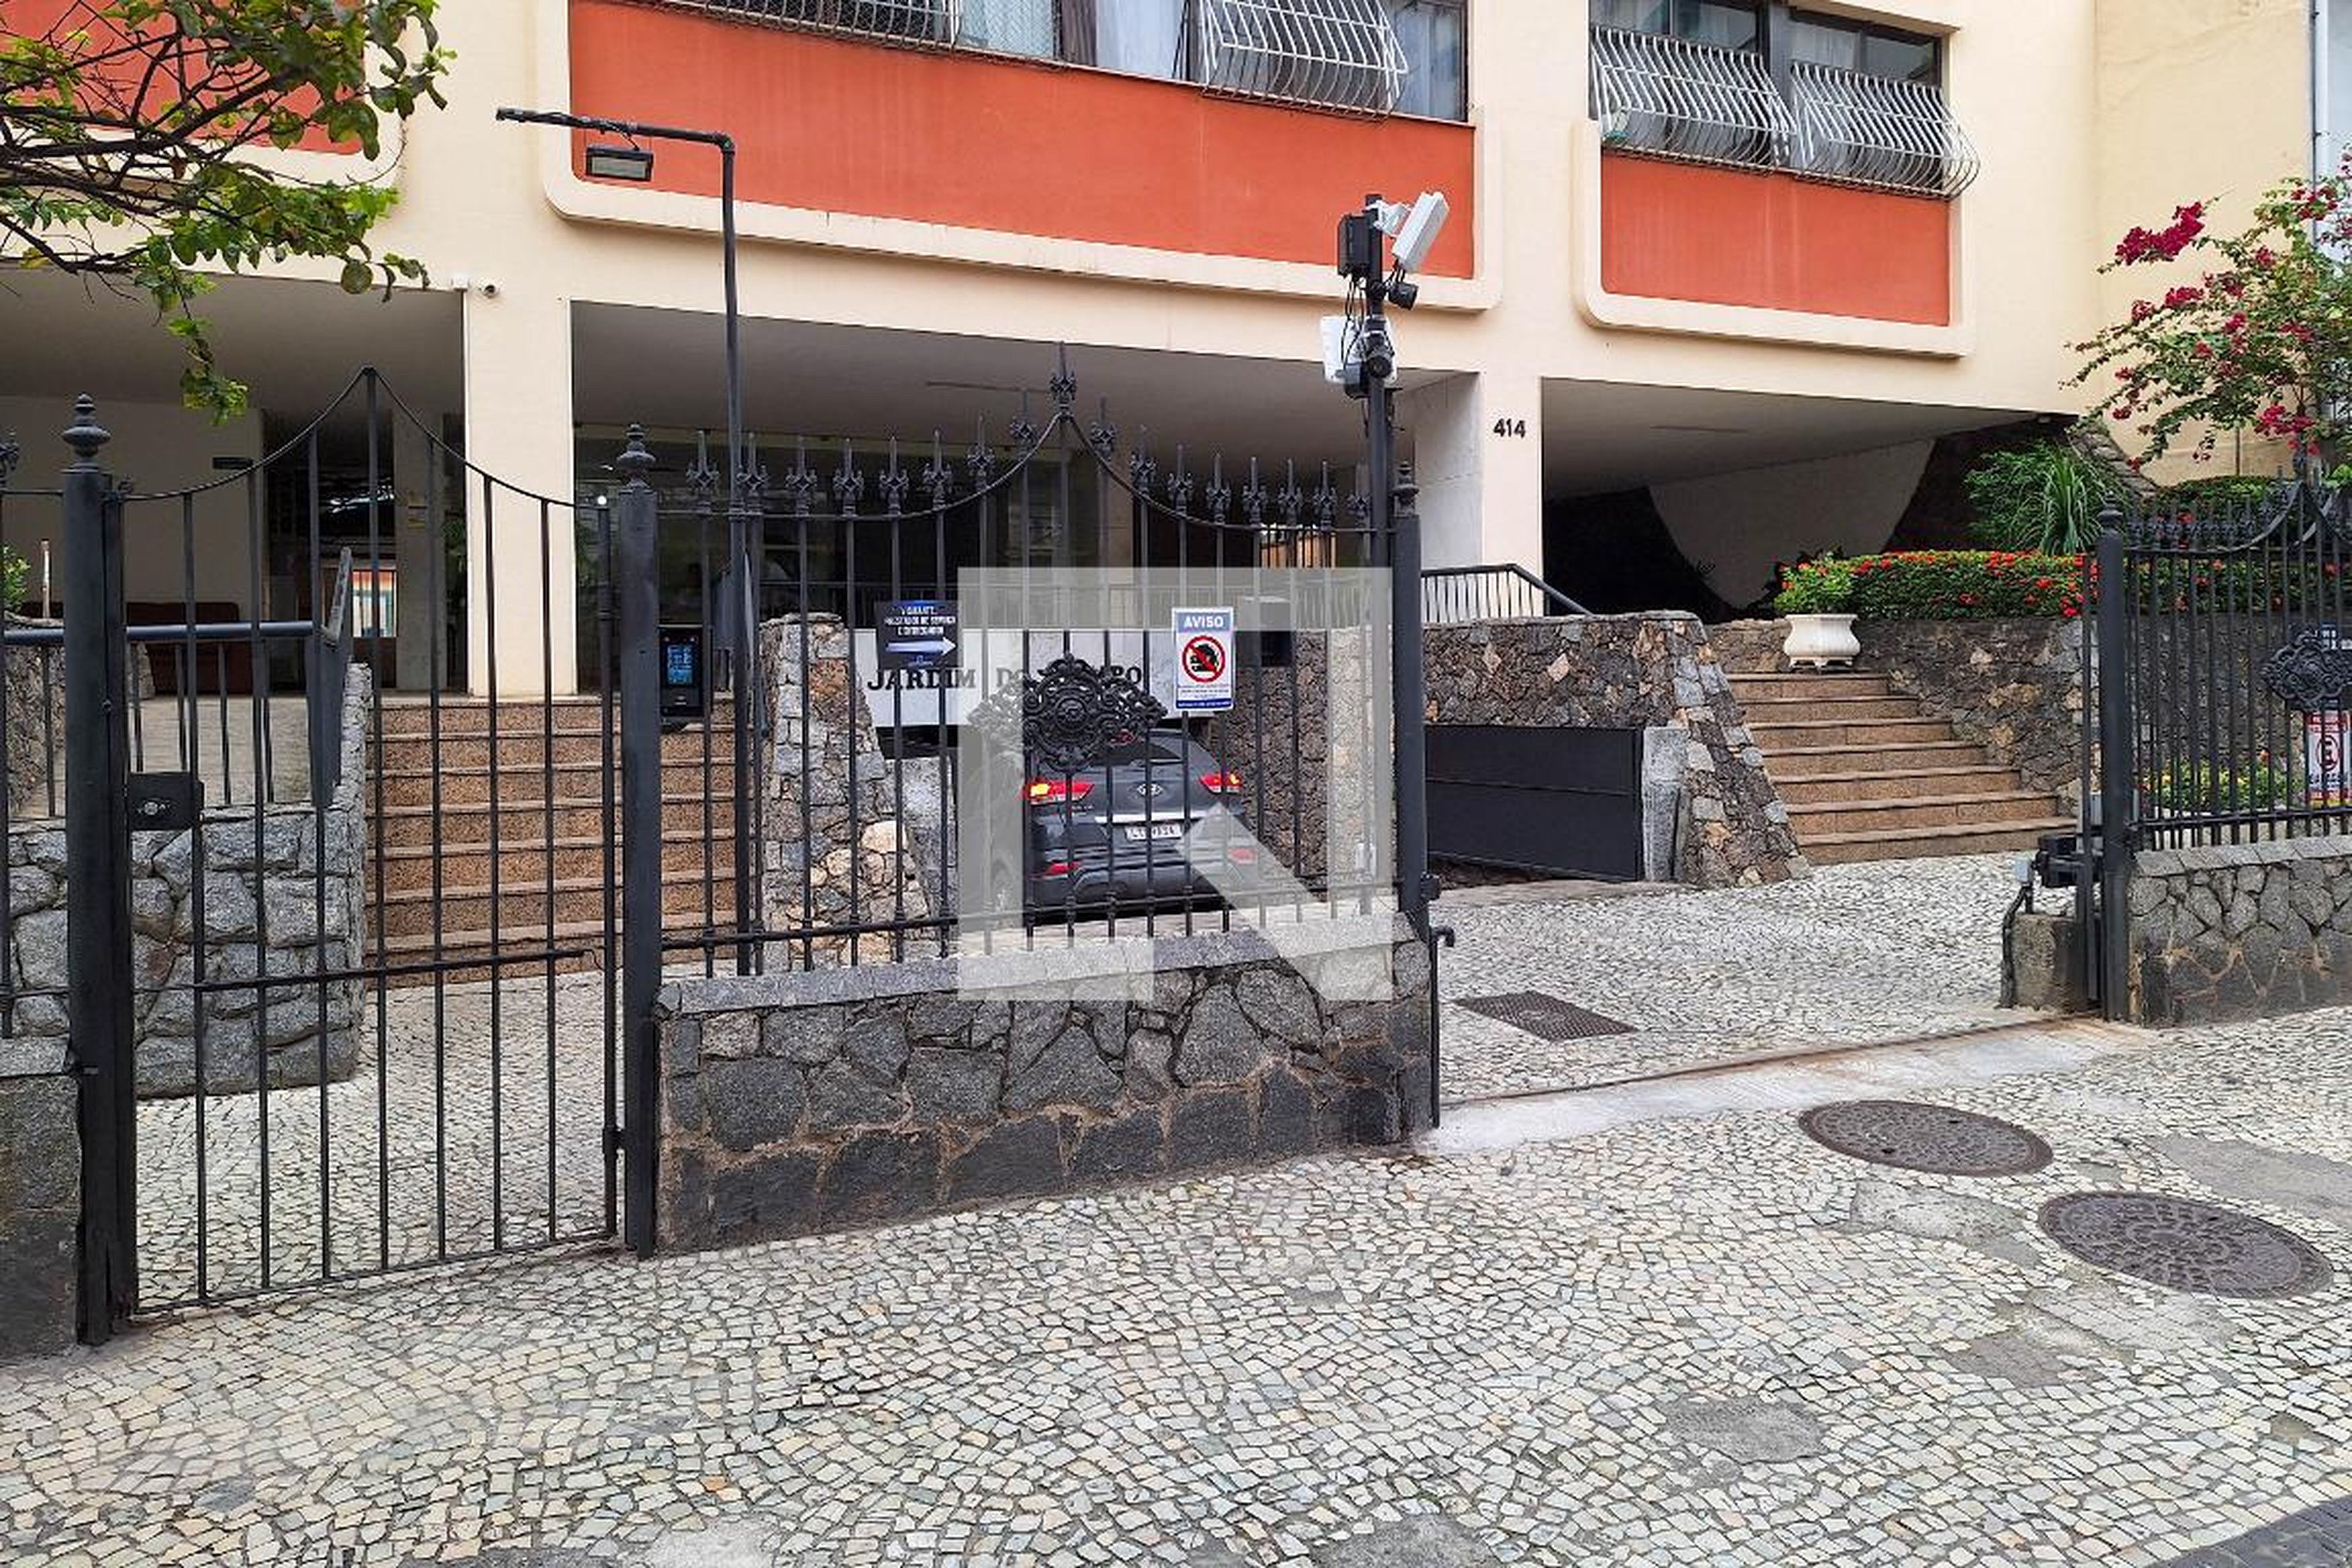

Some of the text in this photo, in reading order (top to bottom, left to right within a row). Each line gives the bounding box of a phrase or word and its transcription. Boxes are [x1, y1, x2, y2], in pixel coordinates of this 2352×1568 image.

[1494, 418, 1526, 439] 414
[1184, 616, 1224, 628] AVISO
[867, 669, 976, 690] JARDIM
